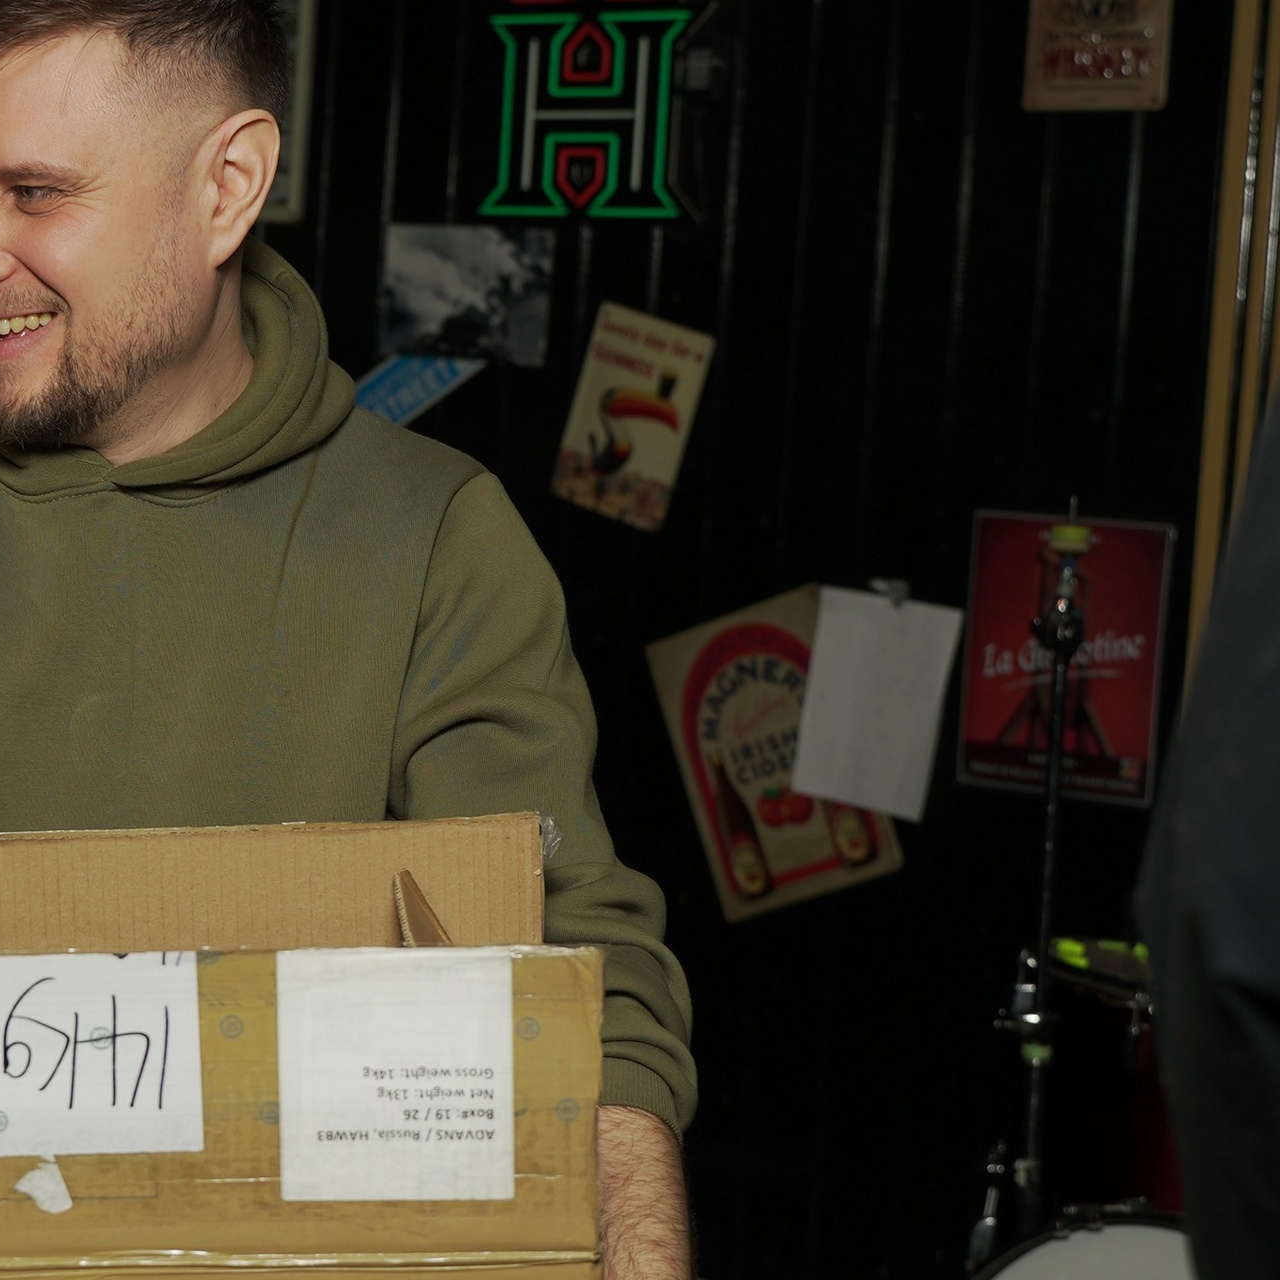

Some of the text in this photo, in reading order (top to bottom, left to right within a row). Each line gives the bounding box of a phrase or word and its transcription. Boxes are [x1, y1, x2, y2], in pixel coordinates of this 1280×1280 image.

[981, 630, 1147, 678] La Guotine
[701, 655, 806, 741] MAGNER
[363, 1066, 395, 1080] 14kg
[455, 1068, 494, 1080] Gross
[377, 1086, 409, 1100] 13kg
[470, 1088, 494, 1100] Net
[403, 1108, 420, 1120] 26
[435, 1108, 451, 1120] 19
[373, 1127, 421, 1142] Russia,
[435, 1128, 495, 1141] ADVANS
